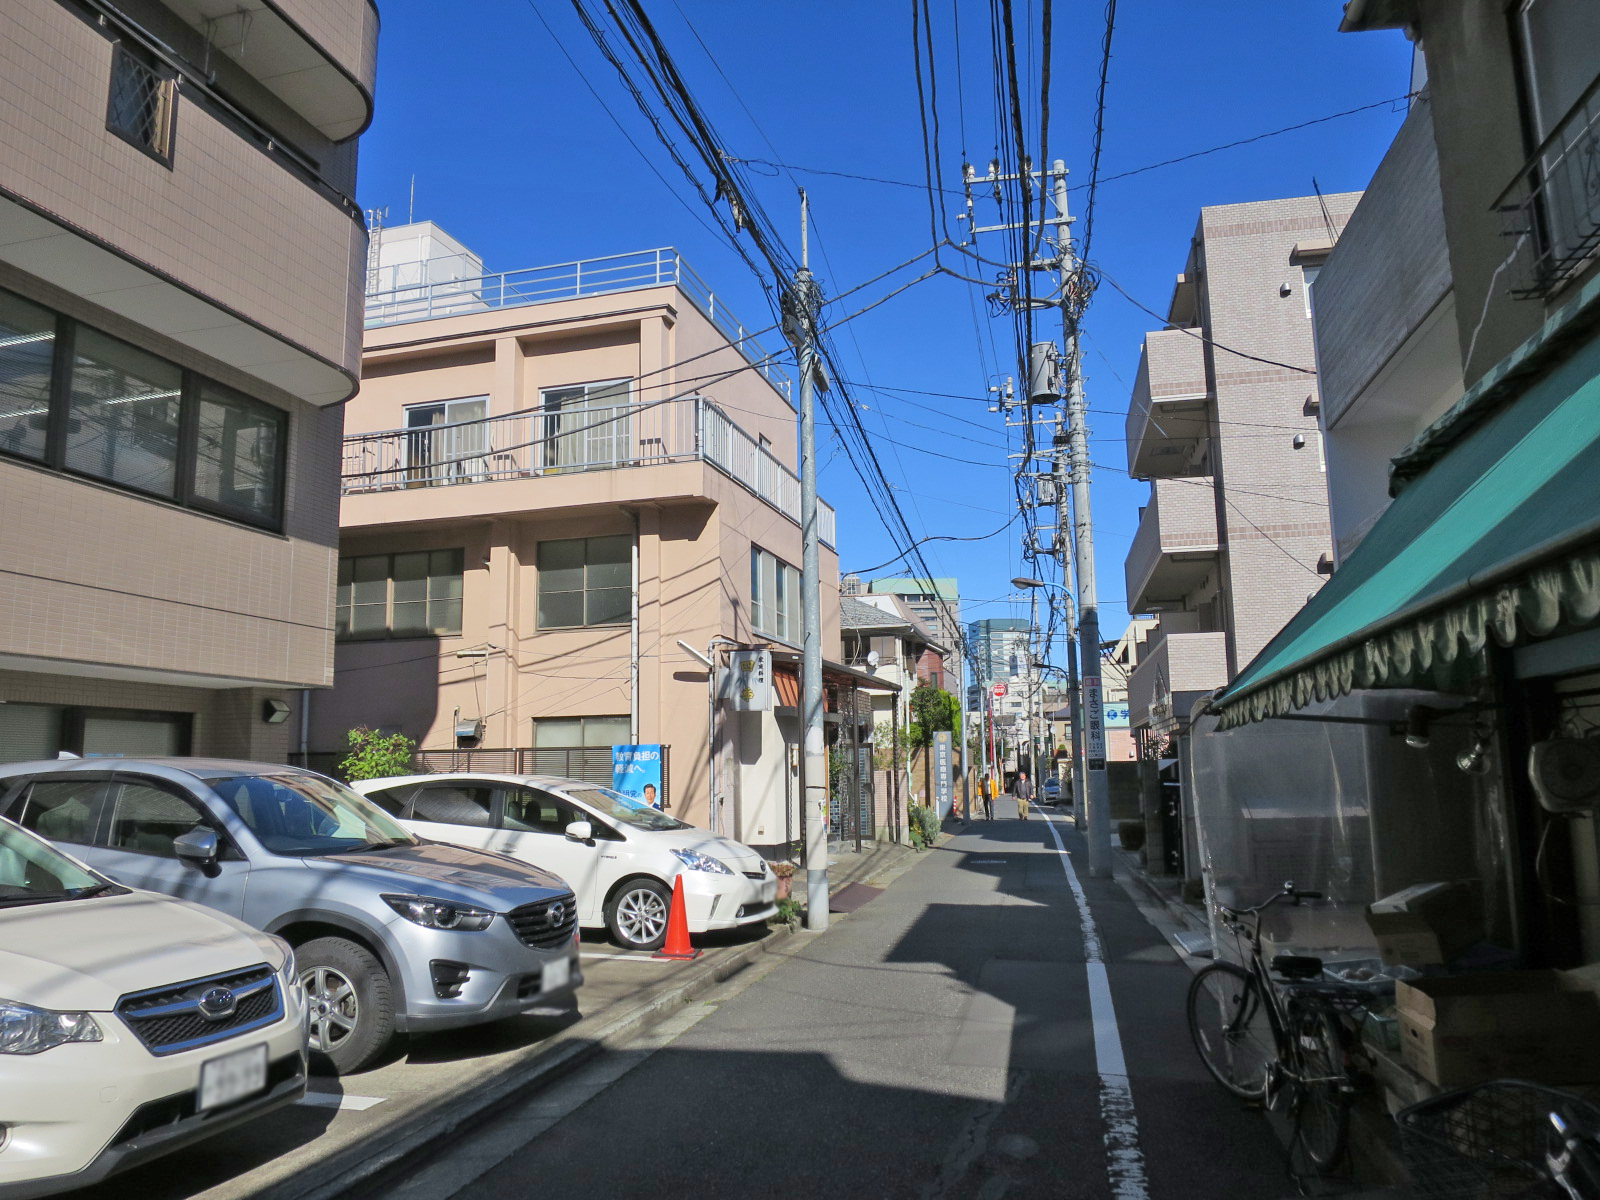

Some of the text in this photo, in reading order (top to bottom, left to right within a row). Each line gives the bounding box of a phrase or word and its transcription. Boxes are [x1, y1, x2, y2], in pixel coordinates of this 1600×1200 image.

[1089, 688, 1101, 741] まさご眼科
[615, 751, 659, 761] 教育負担の
[615, 764, 646, 773] 軽減へ。
[939, 744, 948, 803] 東京医療専門学校
